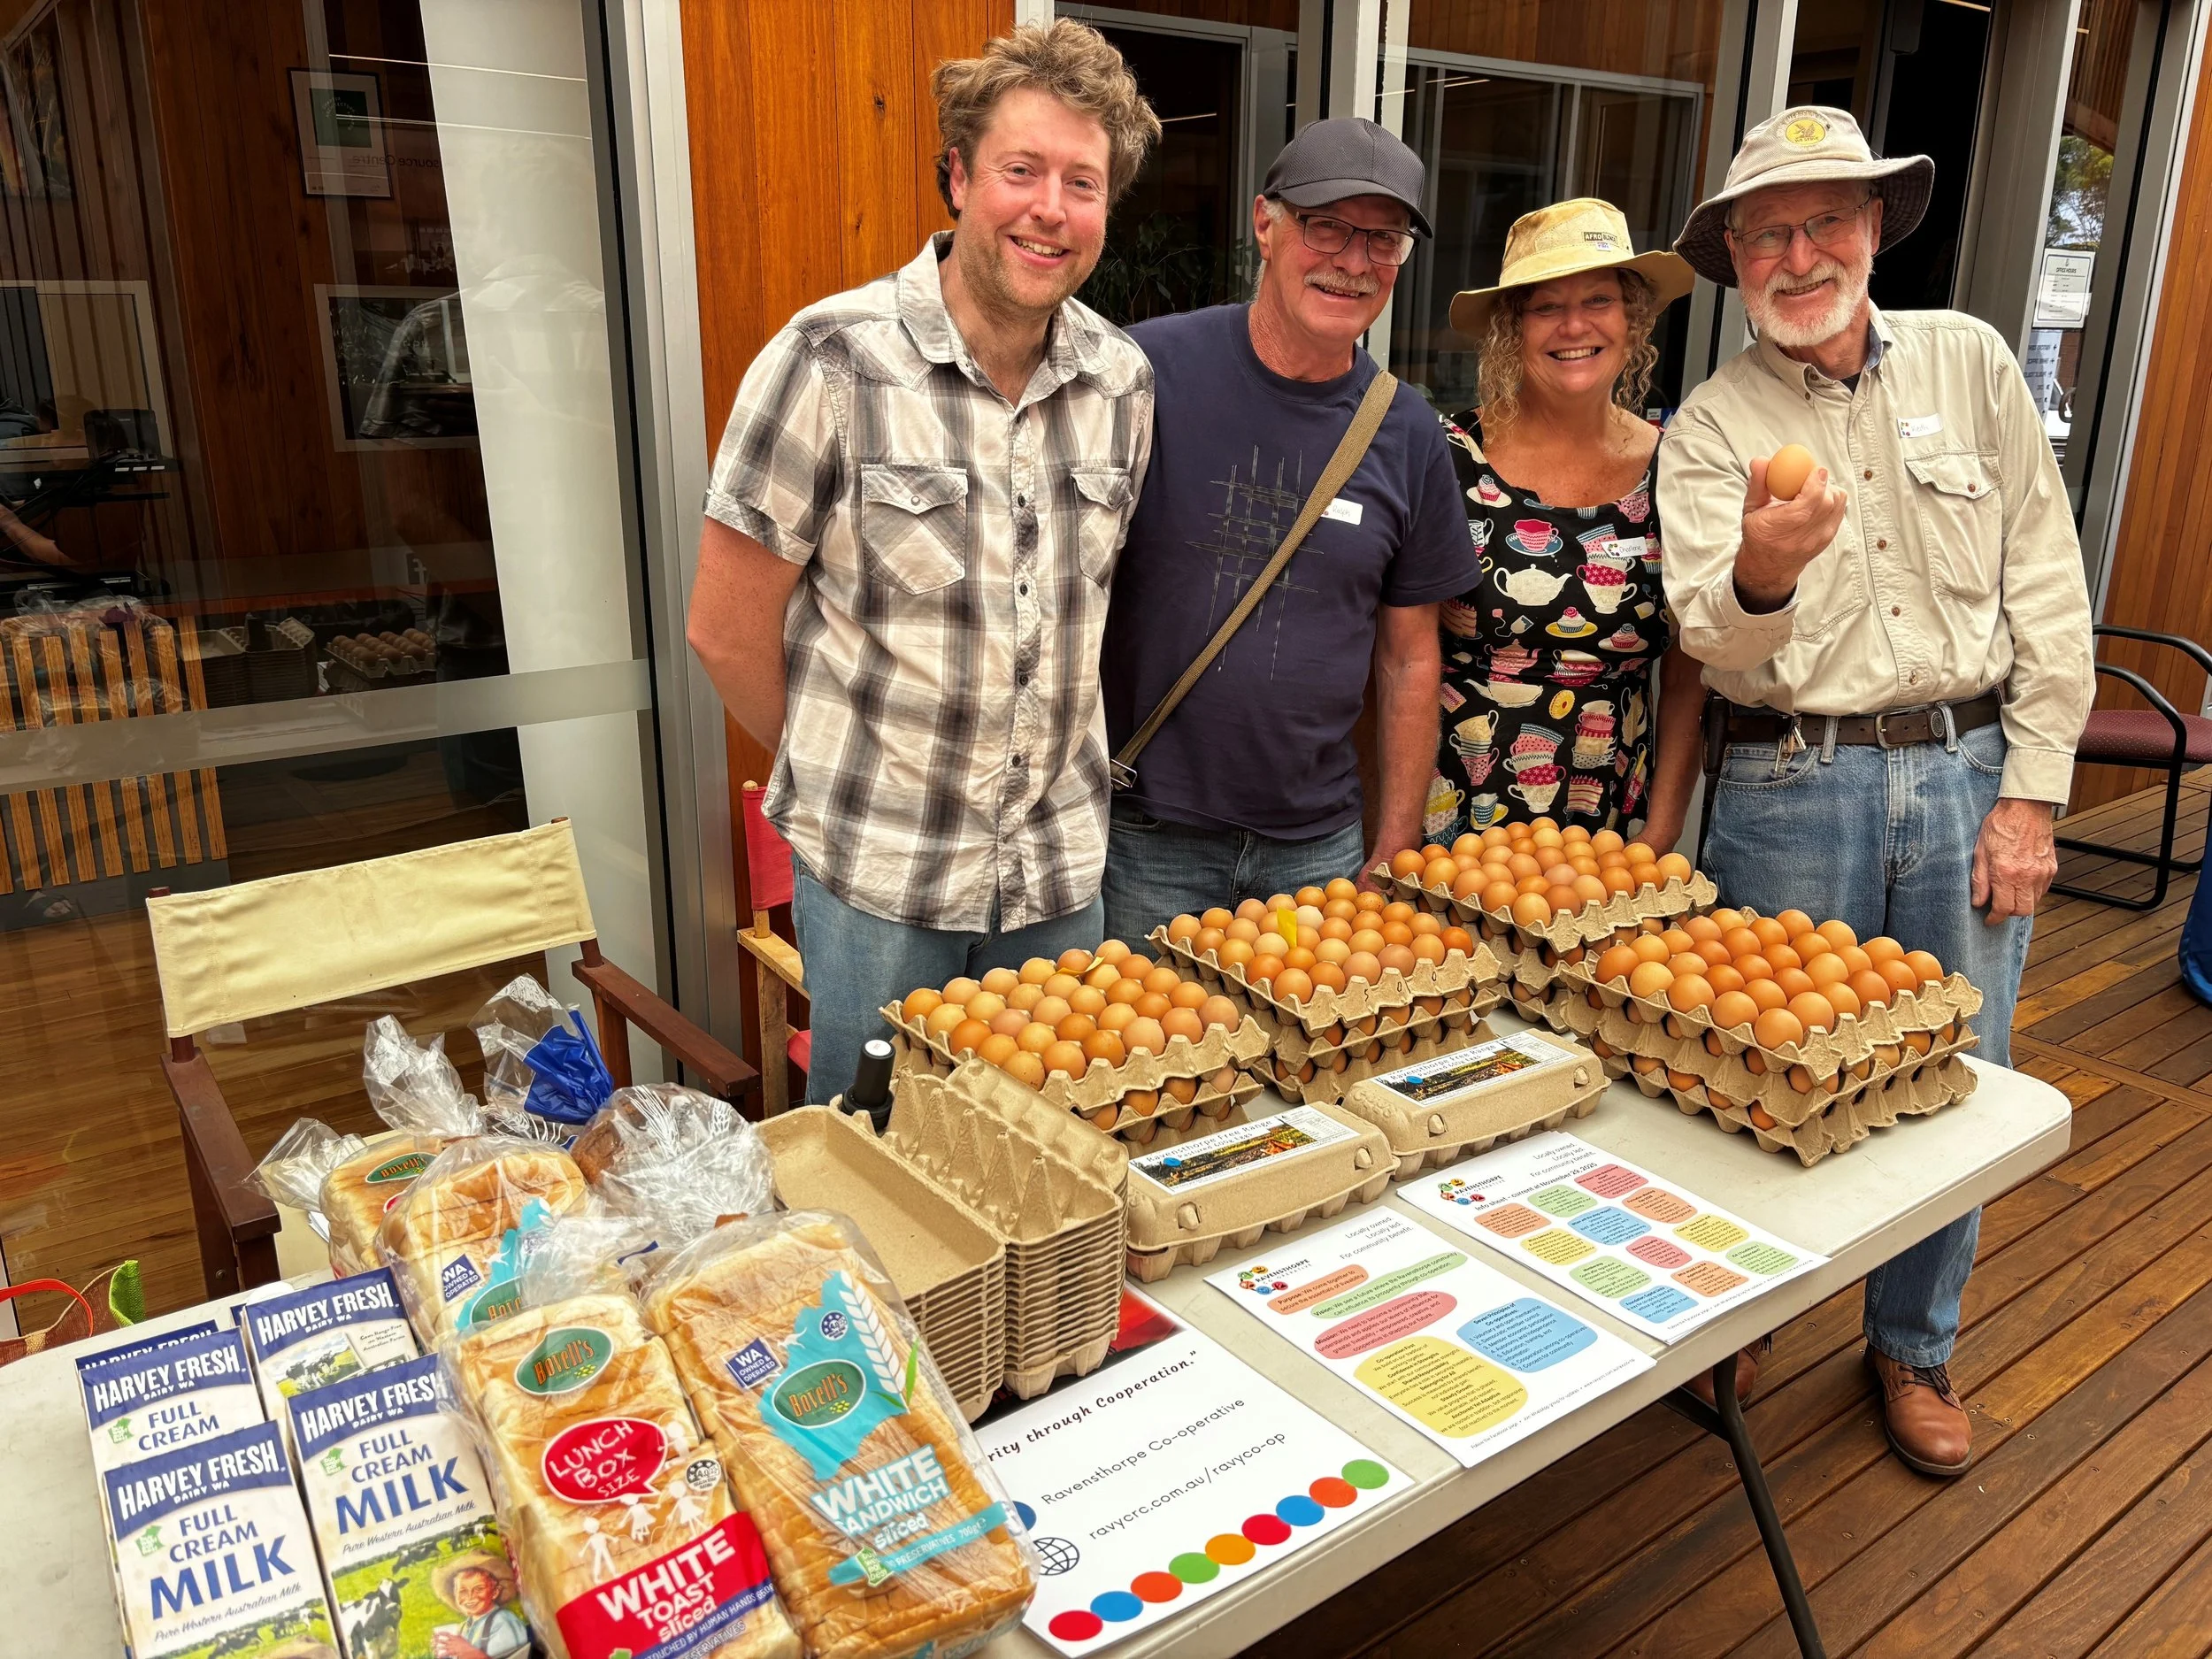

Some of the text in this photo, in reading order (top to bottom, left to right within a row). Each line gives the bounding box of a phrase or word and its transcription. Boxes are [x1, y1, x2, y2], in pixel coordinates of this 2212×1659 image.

[1390, 1044, 1497, 1079] Ravensthorpe Free Range
[1146, 1137, 1216, 1163] Ravensthorpe
[1217, 1128, 1240, 1140] Free
[1241, 1120, 1272, 1133] Range
[1532, 1149, 1556, 1159] Locally
[1552, 1151, 1575, 1161] Locally
[1540, 1159, 1575, 1173] community
[1454, 1174, 1502, 1194] RAVENSTHORPE
[1510, 1187, 1533, 1196] current
[1539, 1172, 1571, 1186] November
[1345, 1217, 1394, 1238] Locally owned.
[1365, 1226, 1391, 1238] Locally
[1351, 1237, 1390, 1254] community
[442, 1263, 467, 1283] WA
[445, 1274, 479, 1298] OPERATED
[1255, 1258, 1309, 1282] RAVENSTHORPE
[1313, 1305, 1334, 1316] Vision:
[1356, 1288, 1373, 1297] future
[1372, 1281, 1389, 1290] where
[1397, 1263, 1432, 1279] Ravensthorpe
[1430, 1252, 1458, 1264] community
[1278, 1292, 1303, 1304] Purpose:
[1325, 1273, 1348, 1284] together
[1280, 1302, 1299, 1310] secure
[1307, 1286, 1333, 1299] essentials
[1343, 1298, 1368, 1310] influence
[1374, 1284, 1402, 1297] prosperity
[1399, 1275, 1421, 1286] through
[256, 1280, 396, 1347] HARVEY FRESH
[304, 1312, 352, 1333] DAIRY WA
[1487, 1305, 1510, 1317] Principles
[534, 1337, 595, 1387] Bovell's
[735, 1348, 764, 1367] WA
[739, 1359, 765, 1377] OWNED
[742, 1360, 776, 1382] OPERATED
[1376, 1348, 1405, 1363] Co-operation
[93, 1363, 170, 1413] HARVEY
[174, 1343, 242, 1386] FRESH
[142, 1379, 196, 1402] DAIRY WA
[788, 1372, 849, 1419] Bovell's
[148, 1400, 202, 1429] FULL
[300, 1370, 449, 1443] HARVEY FRESH
[351, 1405, 405, 1427] DAIRY WA
[138, 1415, 220, 1452] CREAM
[358, 1427, 414, 1460] FULL
[552, 1420, 635, 1479] LUNCH
[987, 1439, 1021, 1465] rity
[1026, 1403, 1093, 1445] through
[350, 1443, 434, 1486] CREAM
[575, 1447, 638, 1490] BOX
[1041, 1397, 1246, 1507] Ravensthorpe Co-operative
[117, 1462, 203, 1519] HARVEY
[207, 1440, 280, 1486] FRESH
[173, 1479, 231, 1504] DAIRY WA
[334, 1455, 470, 1538] MILK
[595, 1471, 642, 1499] SIZE
[811, 1444, 943, 1520] WHITE
[1088, 1428, 1286, 1541] ravycrc.com.au/ravyco-op
[179, 1503, 239, 1538] FULL
[833, 1476, 950, 1534] SANDWICH
[169, 1521, 259, 1564] CREAM
[342, 1497, 477, 1555] Pure Western Australian Milk
[873, 1512, 930, 1550] sliced
[895, 1532, 956, 1566] PRESERVATIVES
[150, 1533, 297, 1621] MILK
[596, 1530, 737, 1624] WHITE
[154, 1581, 303, 1644] Pure Western Australian Milk
[636, 1571, 716, 1631] TOAST
[657, 1594, 718, 1643] sliced
[687, 1629, 699, 1644] BY
[699, 1607, 731, 1636] HUMAN
[729, 1593, 758, 1615] HANDS
